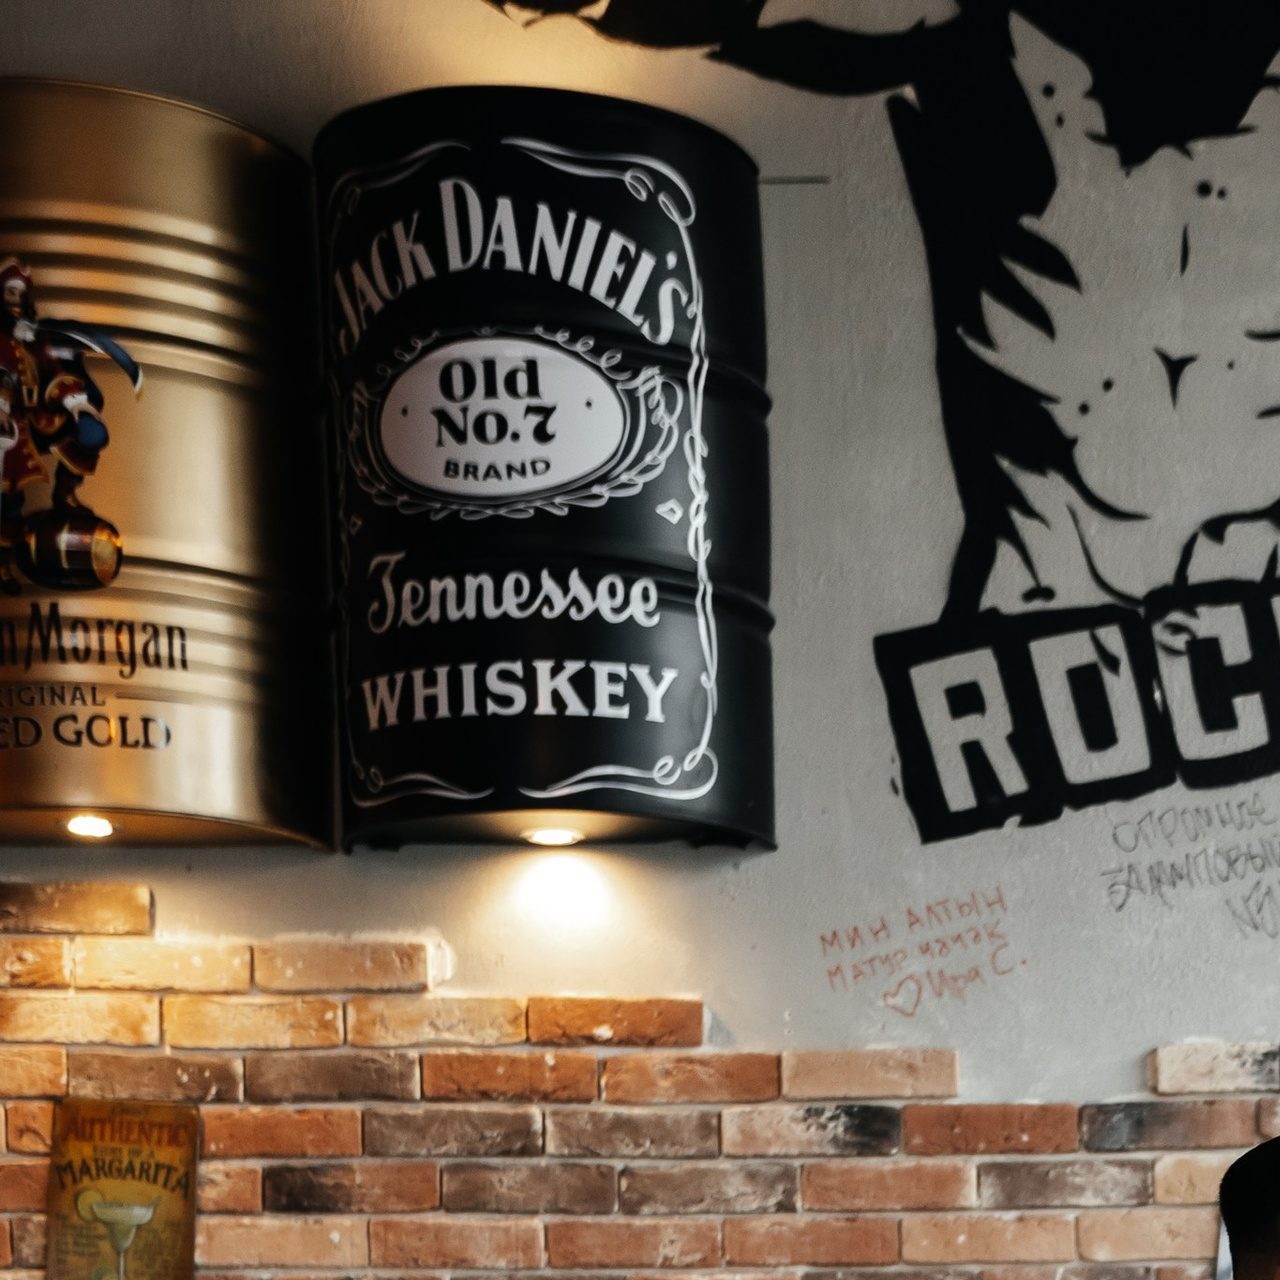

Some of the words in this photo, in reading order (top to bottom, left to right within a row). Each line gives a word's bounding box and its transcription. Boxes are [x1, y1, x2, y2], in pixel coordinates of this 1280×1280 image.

[335, 211, 437, 354] JACK
[438, 177, 690, 346] DANIEL'S
[439, 357, 543, 404] Old
[443, 458, 551, 482] BRAND
[367, 551, 661, 634] Tennessee
[24, 602, 189, 679] Morgan
[361, 658, 680, 731] WHISKEY
[53, 713, 172, 750] GOLD
[54, 1157, 192, 1199] MARGARITA
